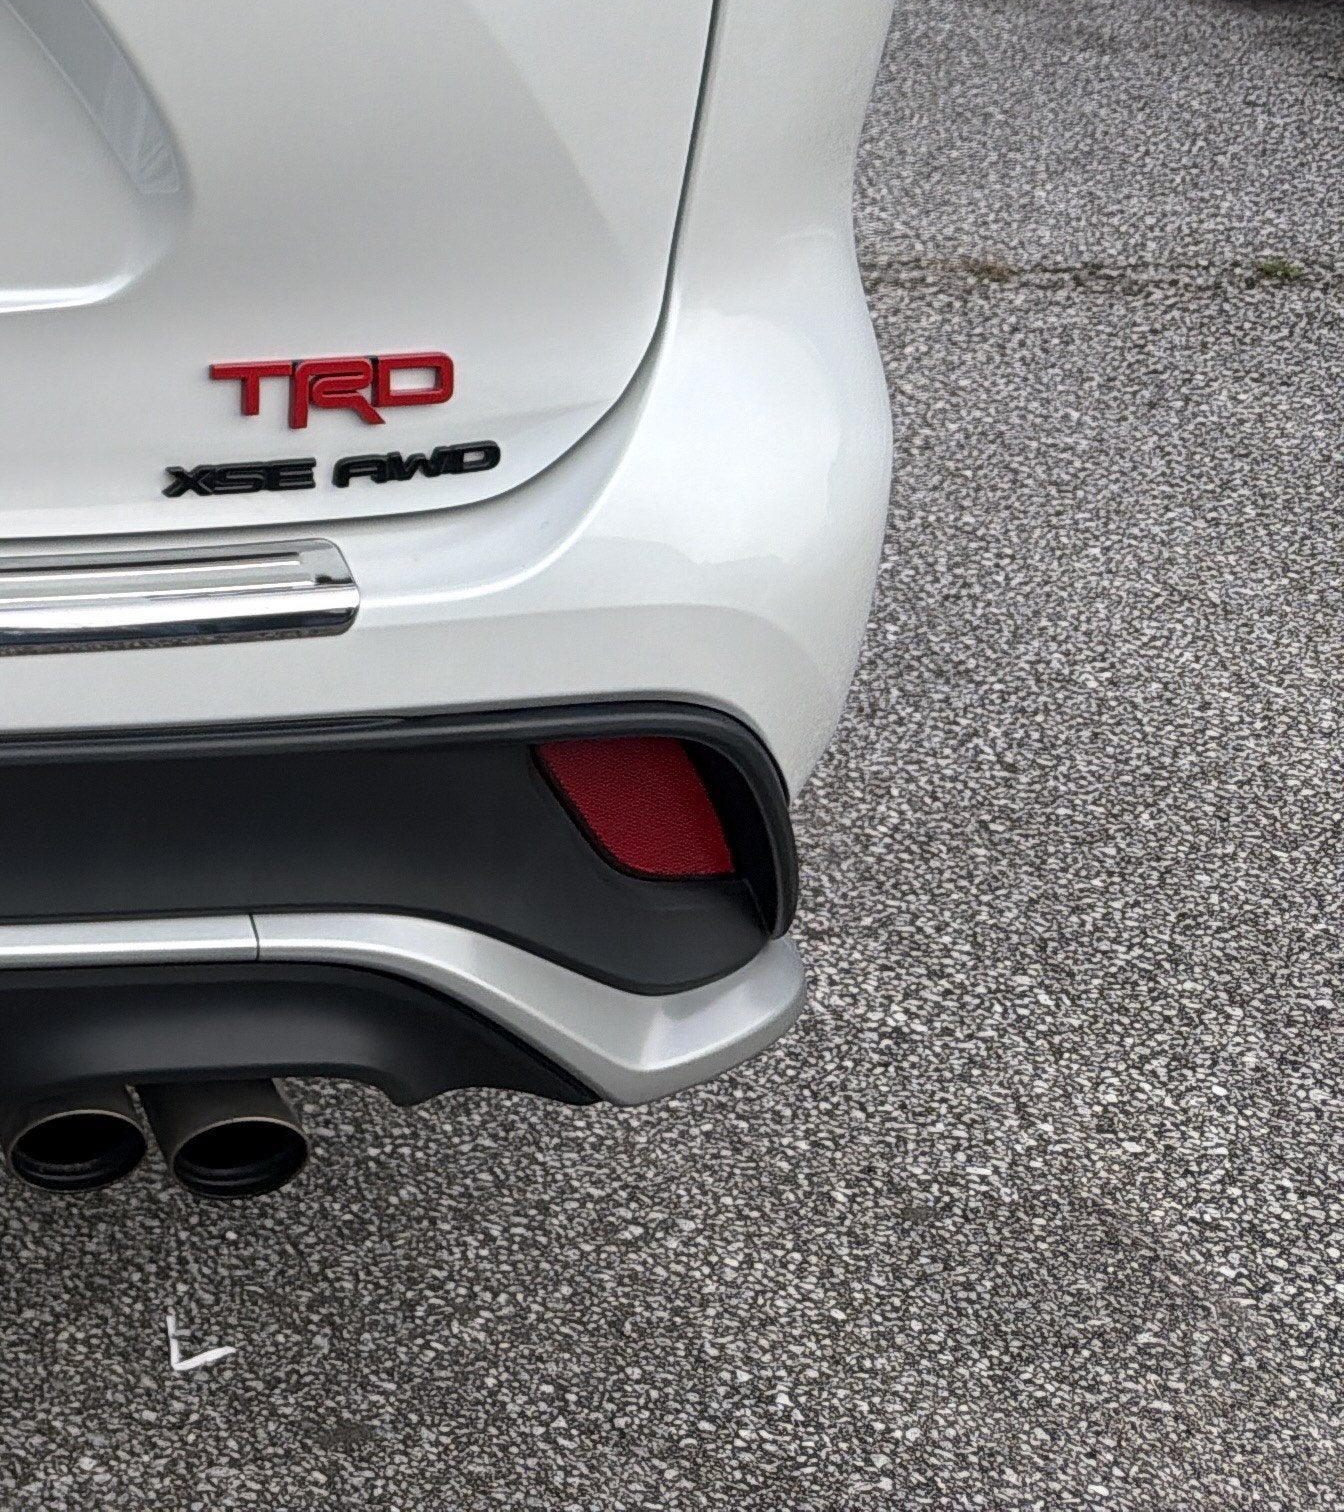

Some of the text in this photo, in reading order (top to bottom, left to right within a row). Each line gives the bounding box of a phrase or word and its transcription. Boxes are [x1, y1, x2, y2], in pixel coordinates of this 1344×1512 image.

[209, 351, 454, 429] TRD
[162, 439, 501, 498] XSE AWD
